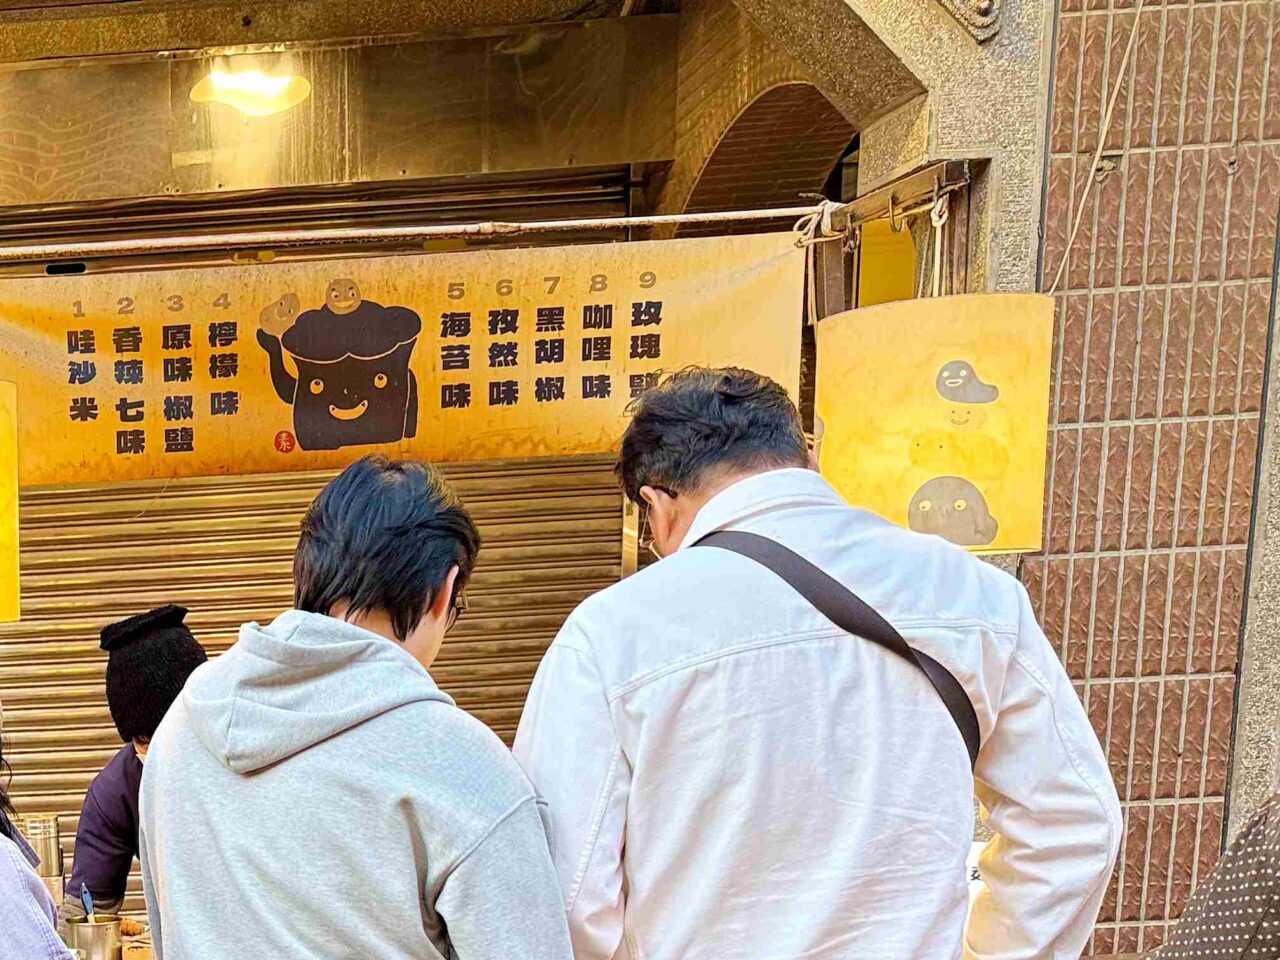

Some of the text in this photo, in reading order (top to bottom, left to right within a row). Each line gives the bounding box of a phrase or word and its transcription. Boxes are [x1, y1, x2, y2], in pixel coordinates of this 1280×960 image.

[73, 293, 231, 318] 1 2 3 4
[447, 271, 657, 300] 5 6 7 8 9
[67, 329, 99, 421] 哇沙米
[112, 326, 146, 454] 香辣七味
[208, 321, 239, 416] 檸檬味
[440, 311, 471, 409] 海苔味
[488, 308, 519, 407] 孜然味
[535, 306, 565, 402] 黑胡椒
[582, 304, 613, 400] 咖哩味
